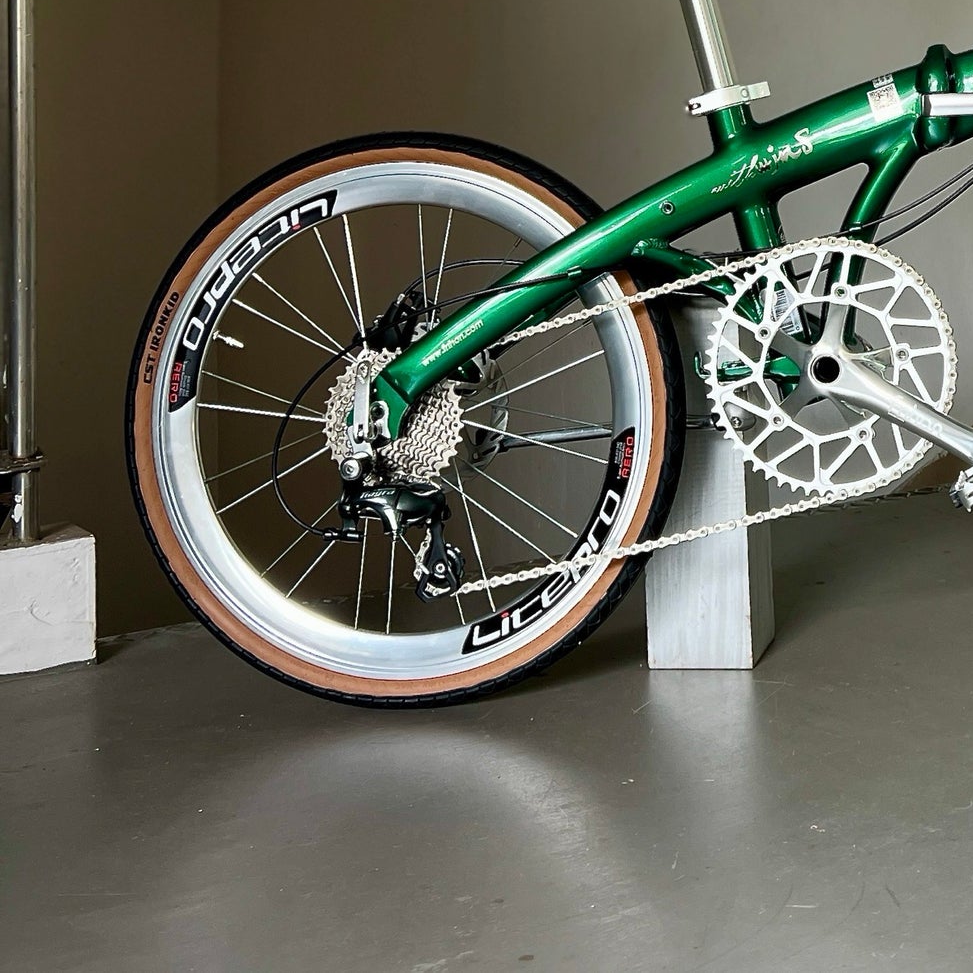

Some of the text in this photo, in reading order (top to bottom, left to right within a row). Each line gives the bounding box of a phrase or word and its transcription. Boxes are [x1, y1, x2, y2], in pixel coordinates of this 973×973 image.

[182, 198, 328, 351] Litepro
[143, 291, 180, 384] CST IRONKID
[169, 362, 183, 403] AERO
[621, 436, 634, 478] AERO
